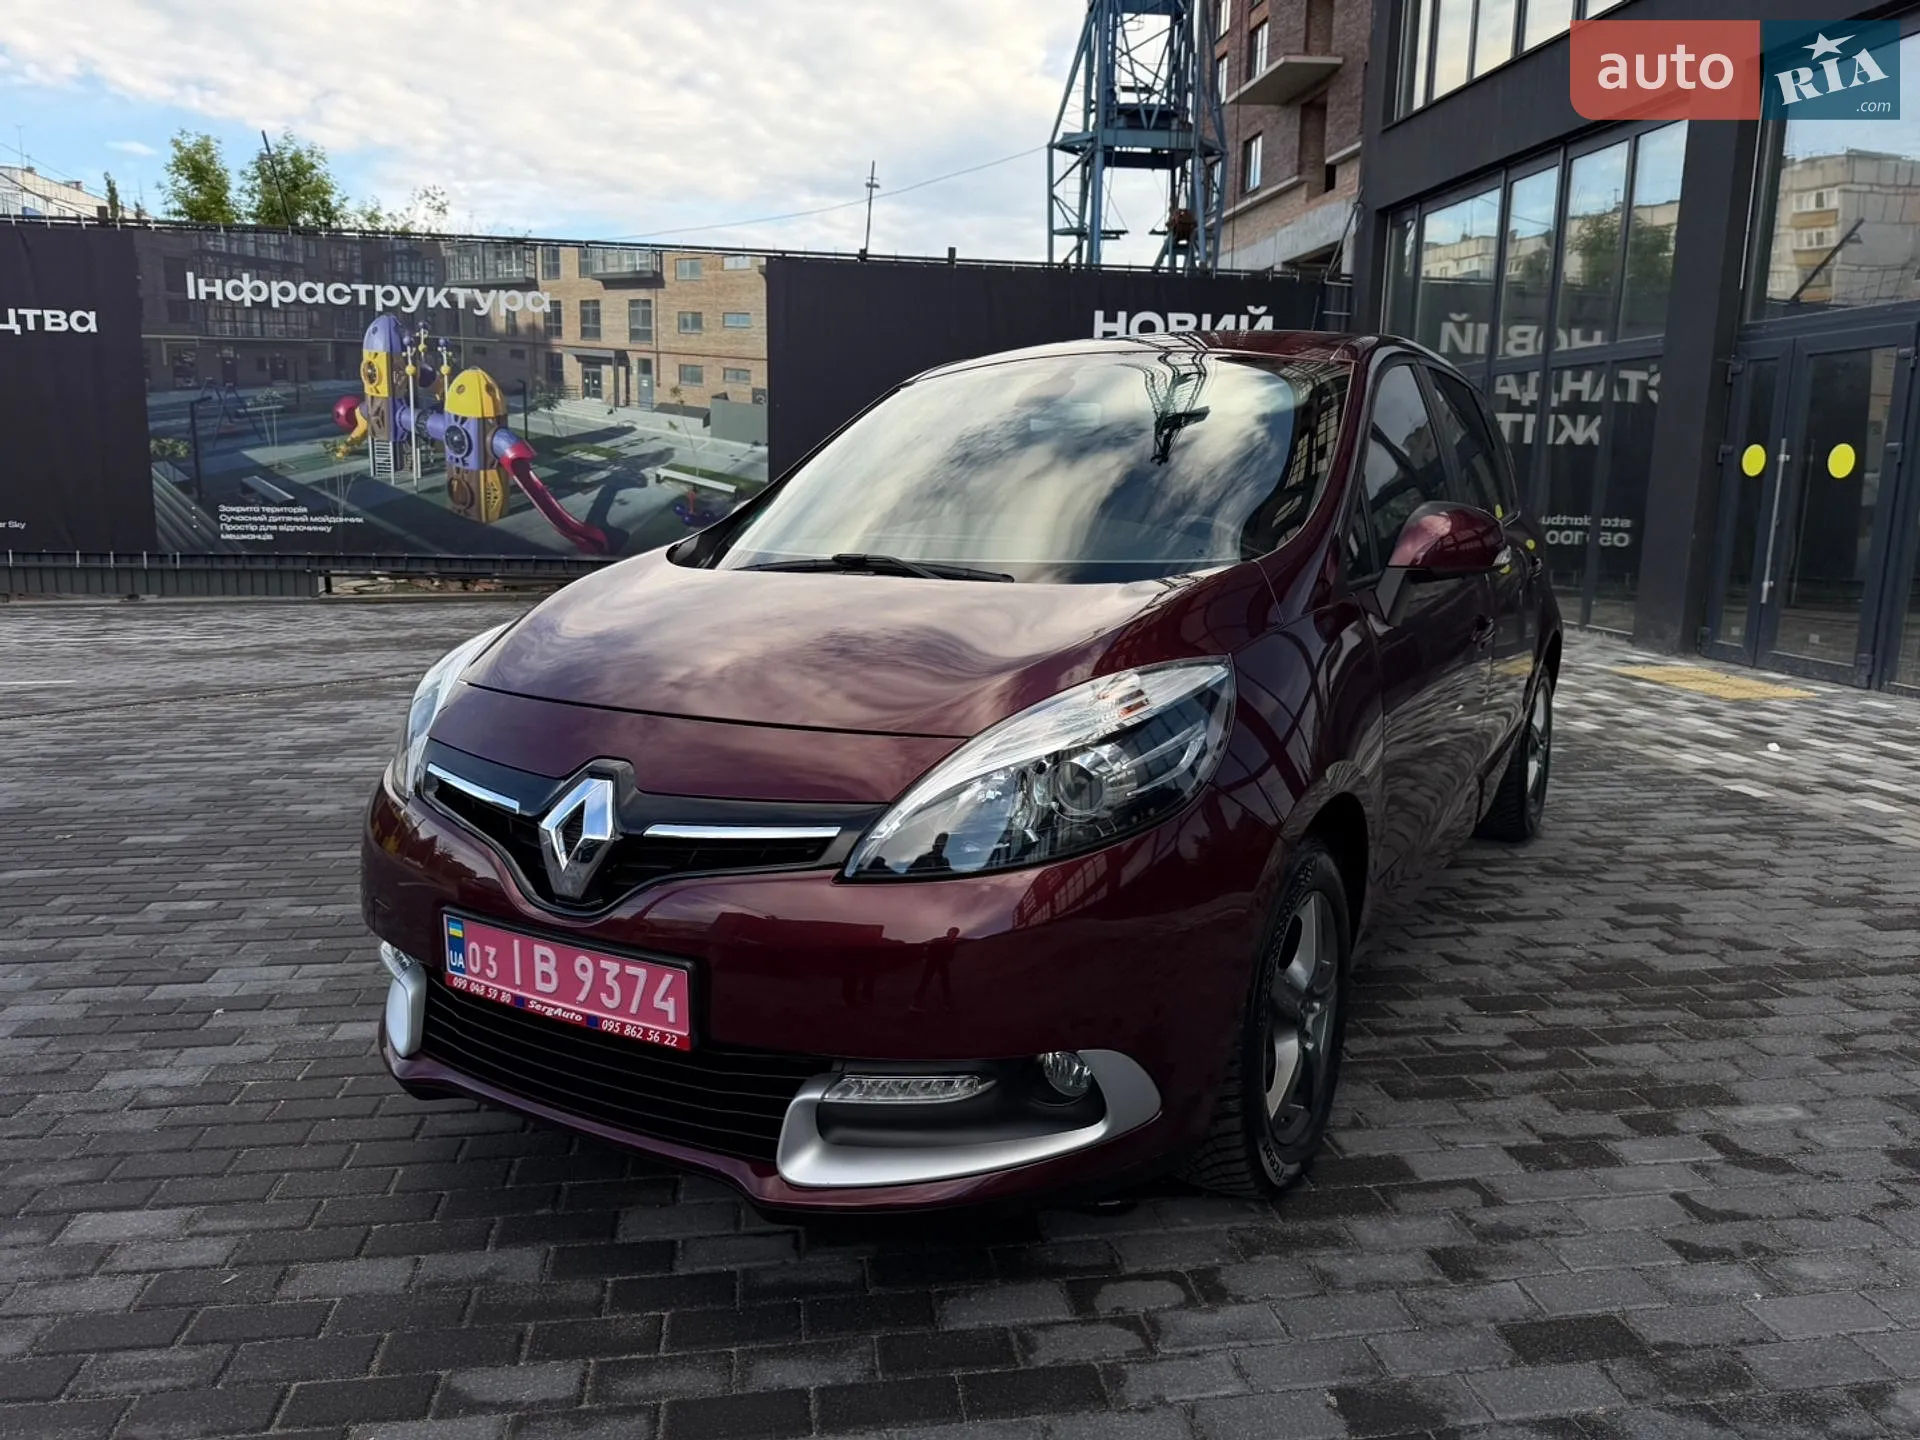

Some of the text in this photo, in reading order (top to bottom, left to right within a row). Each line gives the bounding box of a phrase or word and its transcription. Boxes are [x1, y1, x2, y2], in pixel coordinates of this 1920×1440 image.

[185, 271, 551, 317] Інфраструктура
[449, 949, 465, 968] UA
[468, 941, 498, 979] 03
[573, 955, 677, 1023] 9374
[528, 999, 583, 1022] SergAuto
[601, 1019, 621, 1033] 095
[623, 1025, 643, 1039] 862
[646, 1030, 660, 1043] 56
[663, 1033, 678, 1047] 22
